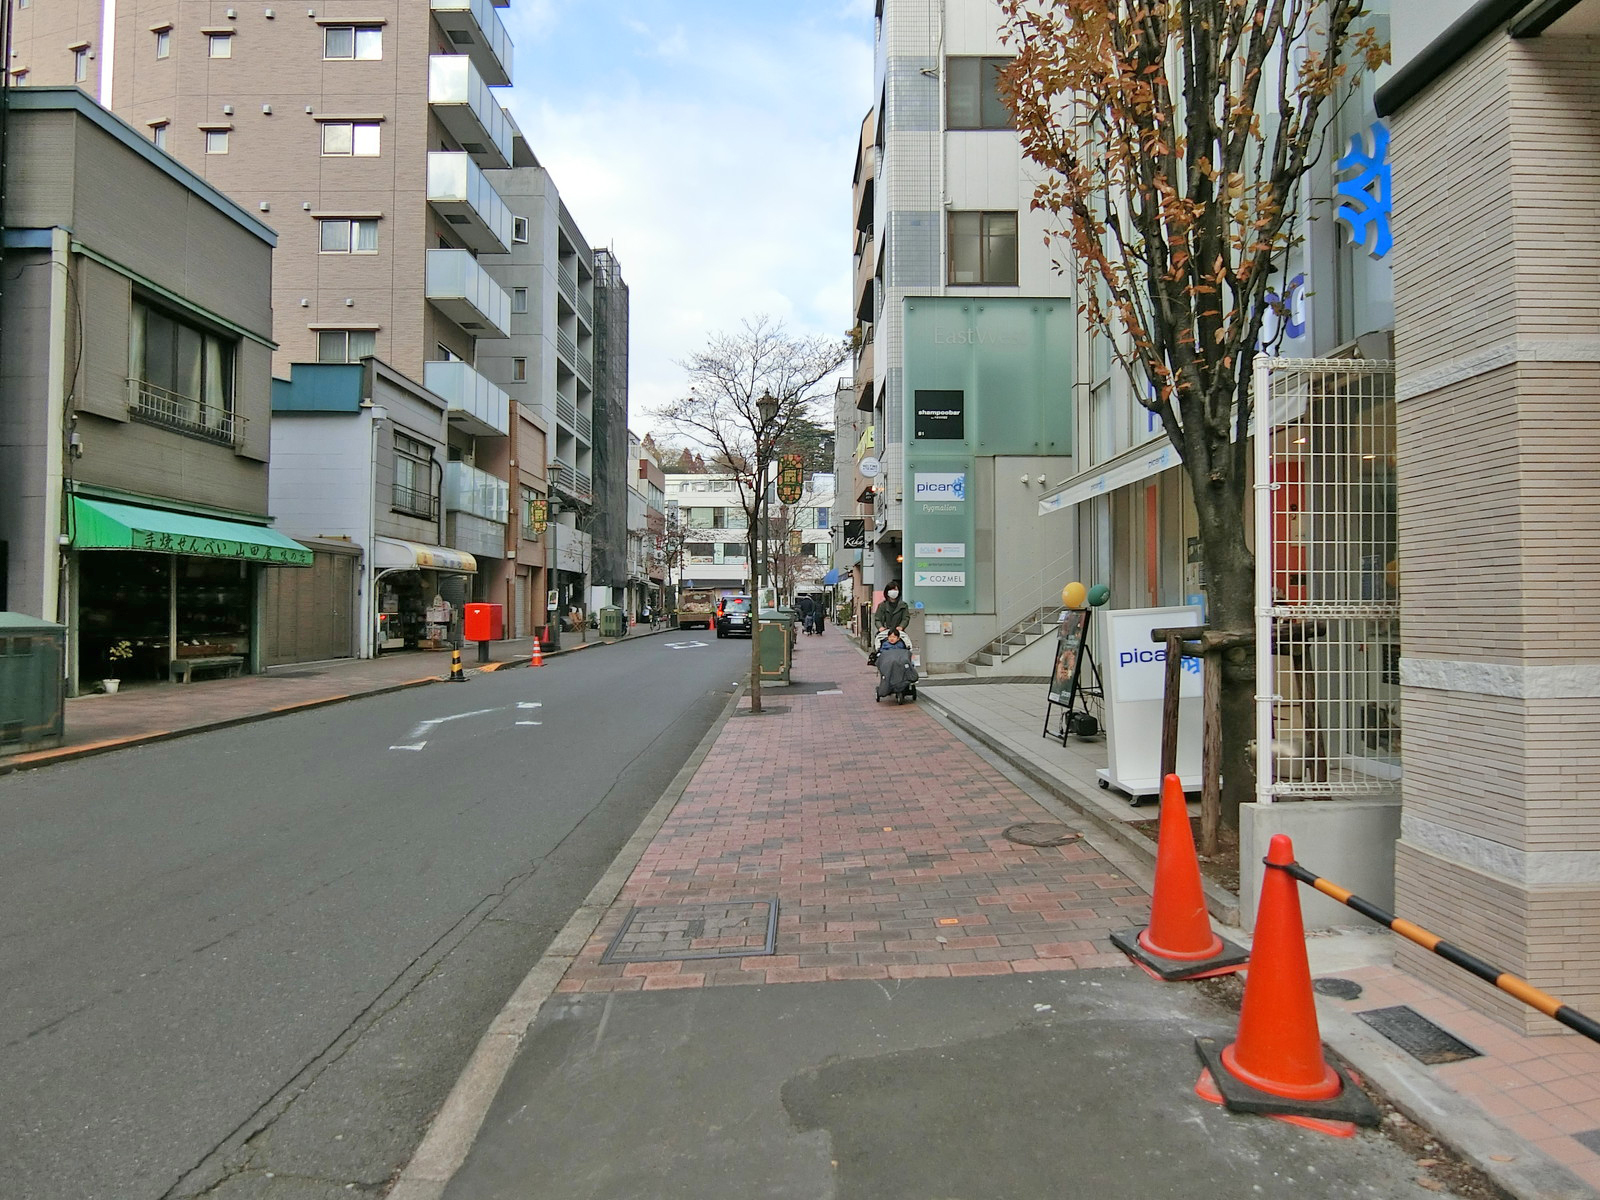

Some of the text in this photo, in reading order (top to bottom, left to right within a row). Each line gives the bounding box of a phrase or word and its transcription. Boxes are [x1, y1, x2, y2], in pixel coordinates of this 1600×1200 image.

[918, 409, 960, 417] shampoobar
[917, 482, 962, 493] picard
[922, 503, 957, 513] Pygmalion
[144, 533, 227, 554] 手焼せんべい
[929, 575, 962, 583] COZMEL
[1119, 648, 1193, 668] pica
